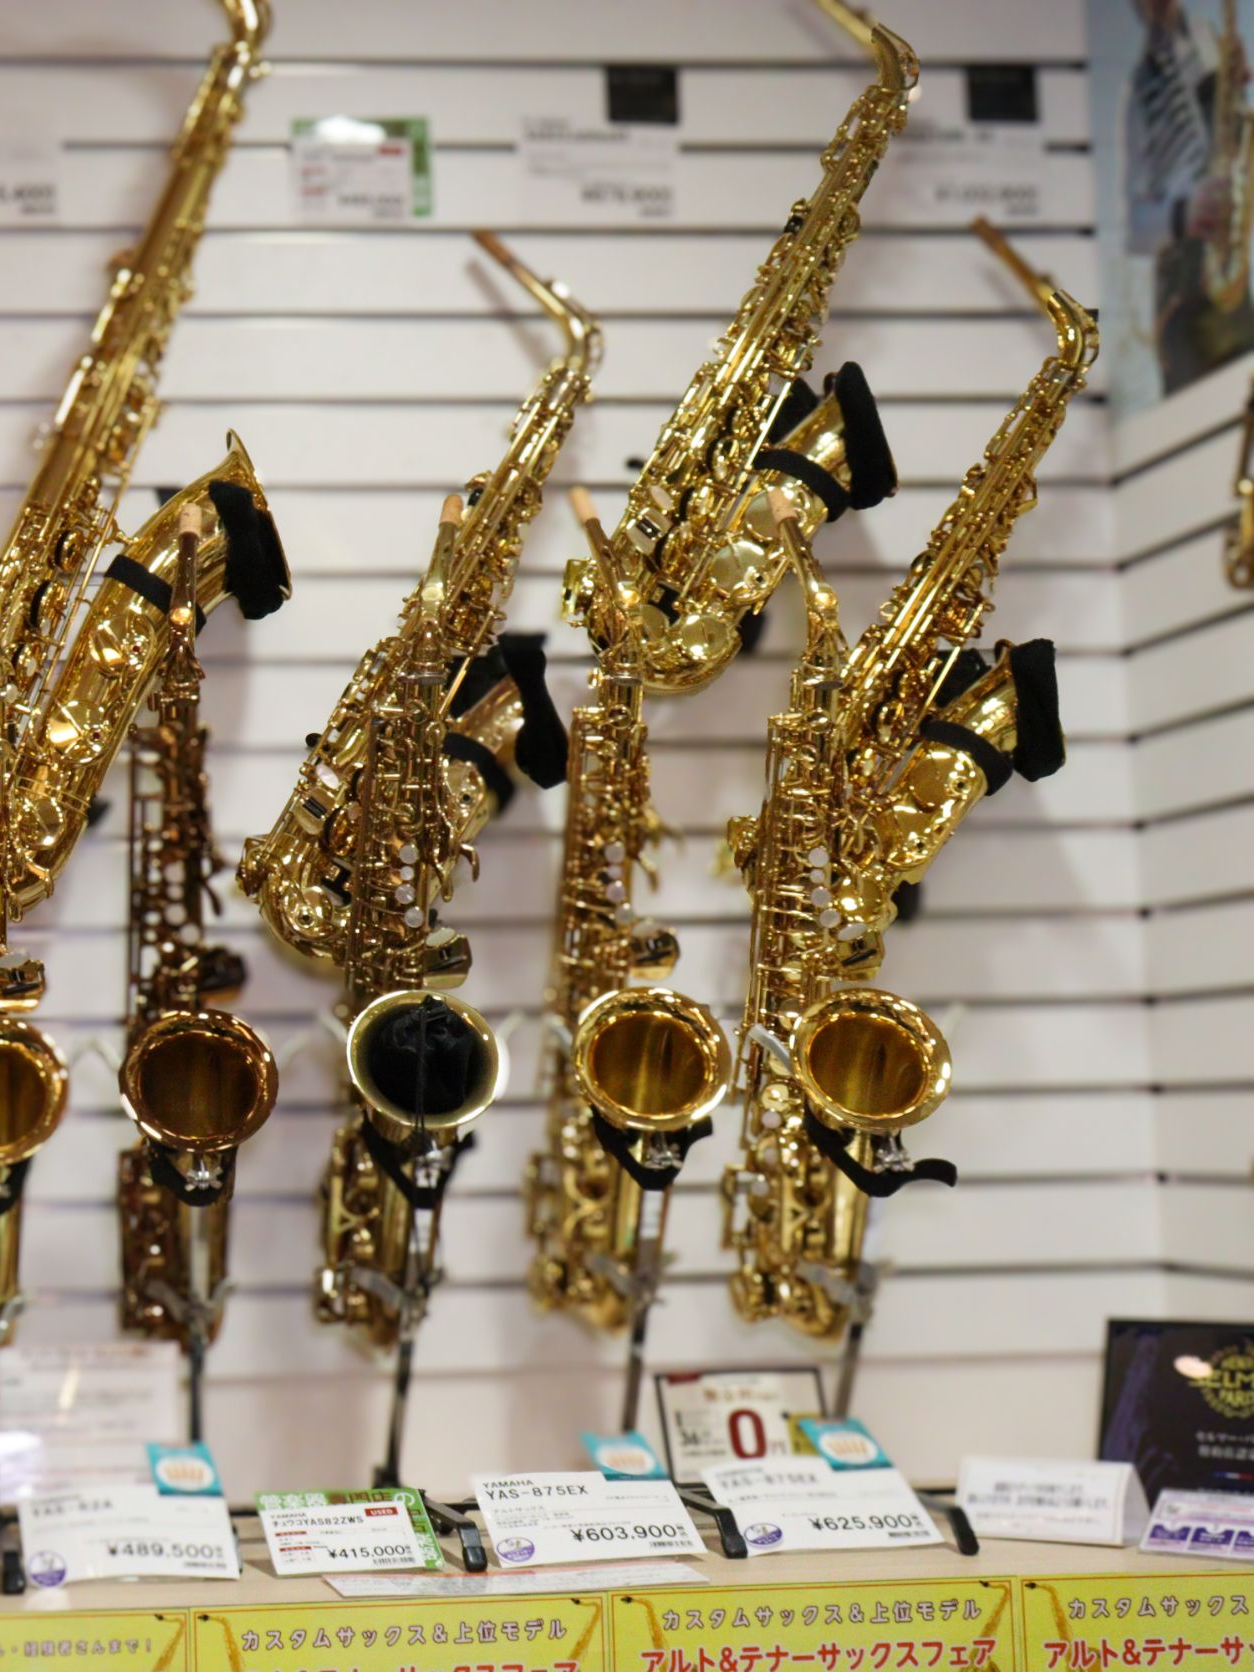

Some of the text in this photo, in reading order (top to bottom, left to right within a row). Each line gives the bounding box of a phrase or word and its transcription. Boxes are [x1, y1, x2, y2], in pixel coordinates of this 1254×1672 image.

[483, 1479, 534, 1489] YAMAHA
[485, 1485, 589, 1501] YAS-875EX
[662, 1599, 982, 1631] カスタムサックス&上位モデル
[241, 1618, 568, 1651] カスタムサックス&上位モデル
[1044, 1635, 1254, 1669] アルト&テナーサ
